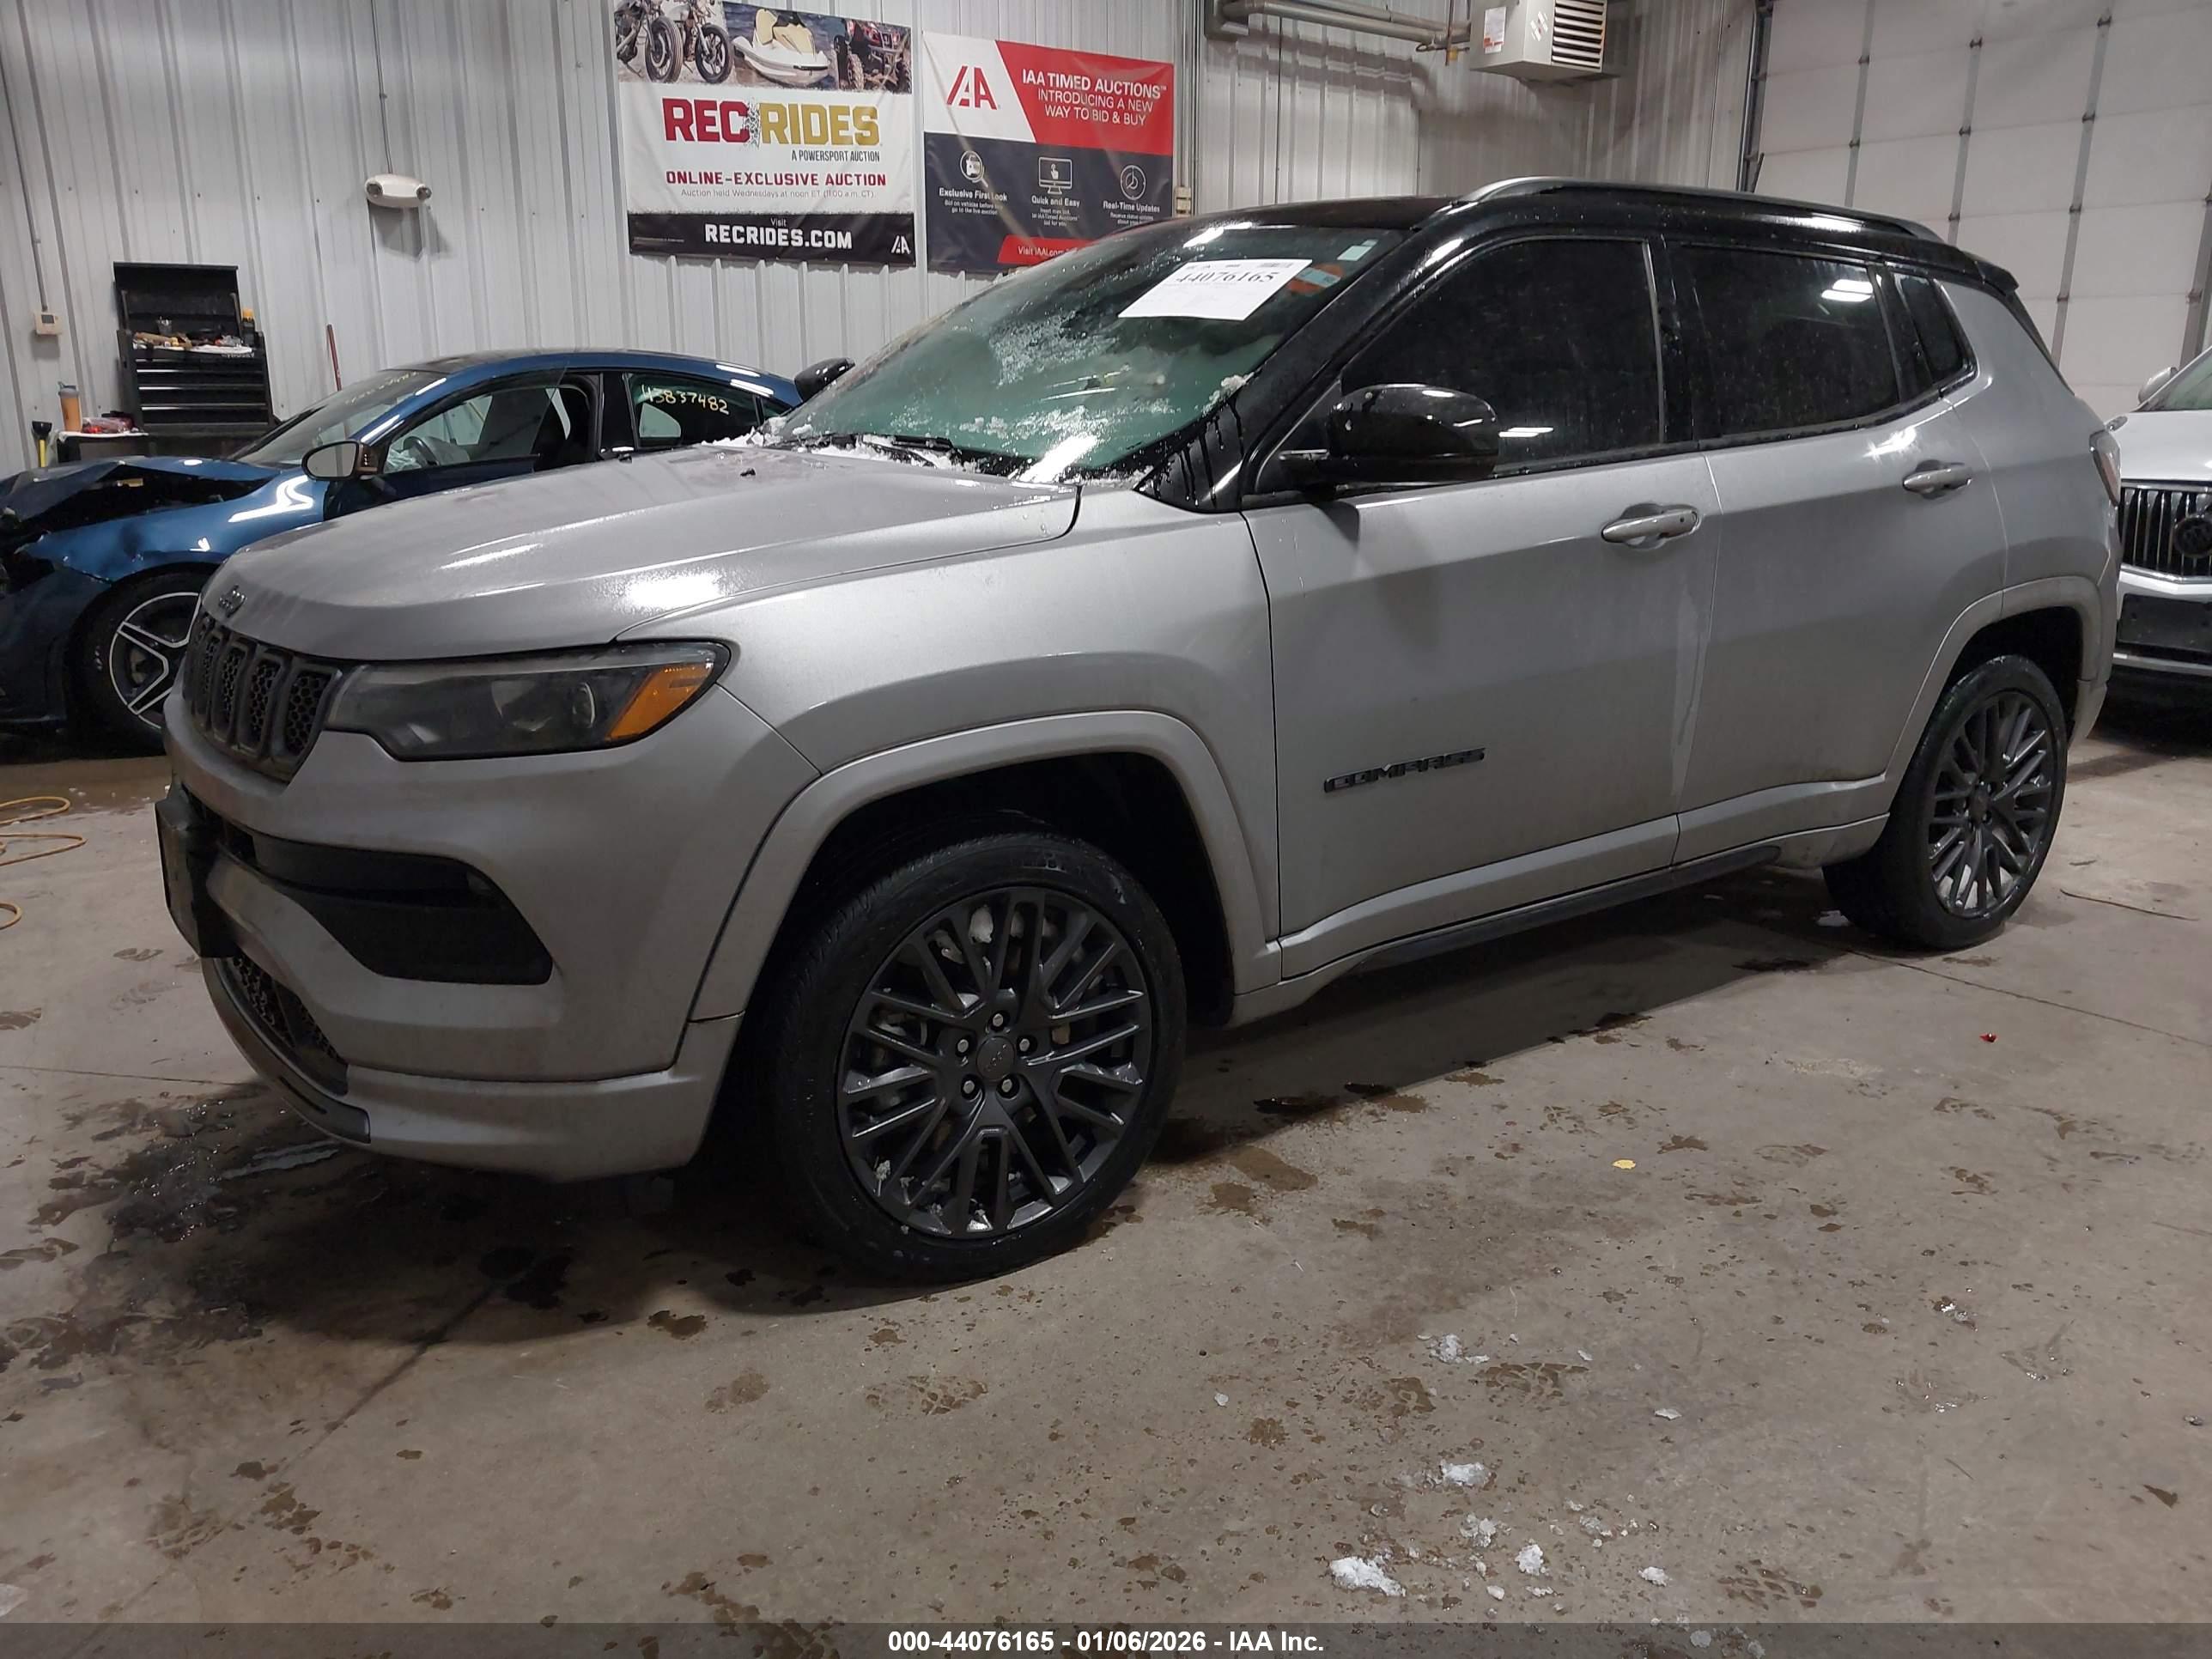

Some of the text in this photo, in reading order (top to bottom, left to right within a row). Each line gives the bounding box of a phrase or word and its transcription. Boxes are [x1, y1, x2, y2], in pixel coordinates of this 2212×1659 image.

[1023, 69, 1045, 86] IAA
[1047, 73, 1091, 90] TIMED
[1038, 88, 1153, 112] INTRODUCING A NEW
[1045, 104, 1146, 126] WAY TO BID & BUY
[792, 149, 880, 162] A POWERSPORT AUCTION
[666, 171, 886, 185] ONLINE-EXCLUSIVE AUCTION
[681, 189, 711, 198] Auction
[714, 188, 730, 198] held
[732, 189, 779, 199] Wednesdays
[939, 188, 1007, 201] Exclusive First Look
[1031, 196, 1080, 208] Quick and Easy
[1103, 201, 1160, 212] Real-Time Updates
[770, 217, 787, 227] Visit
[705, 224, 853, 249] RECRIDES.COM
[1018, 246, 1034, 256] Visit
[1323, 746, 1486, 793] COMPASS
